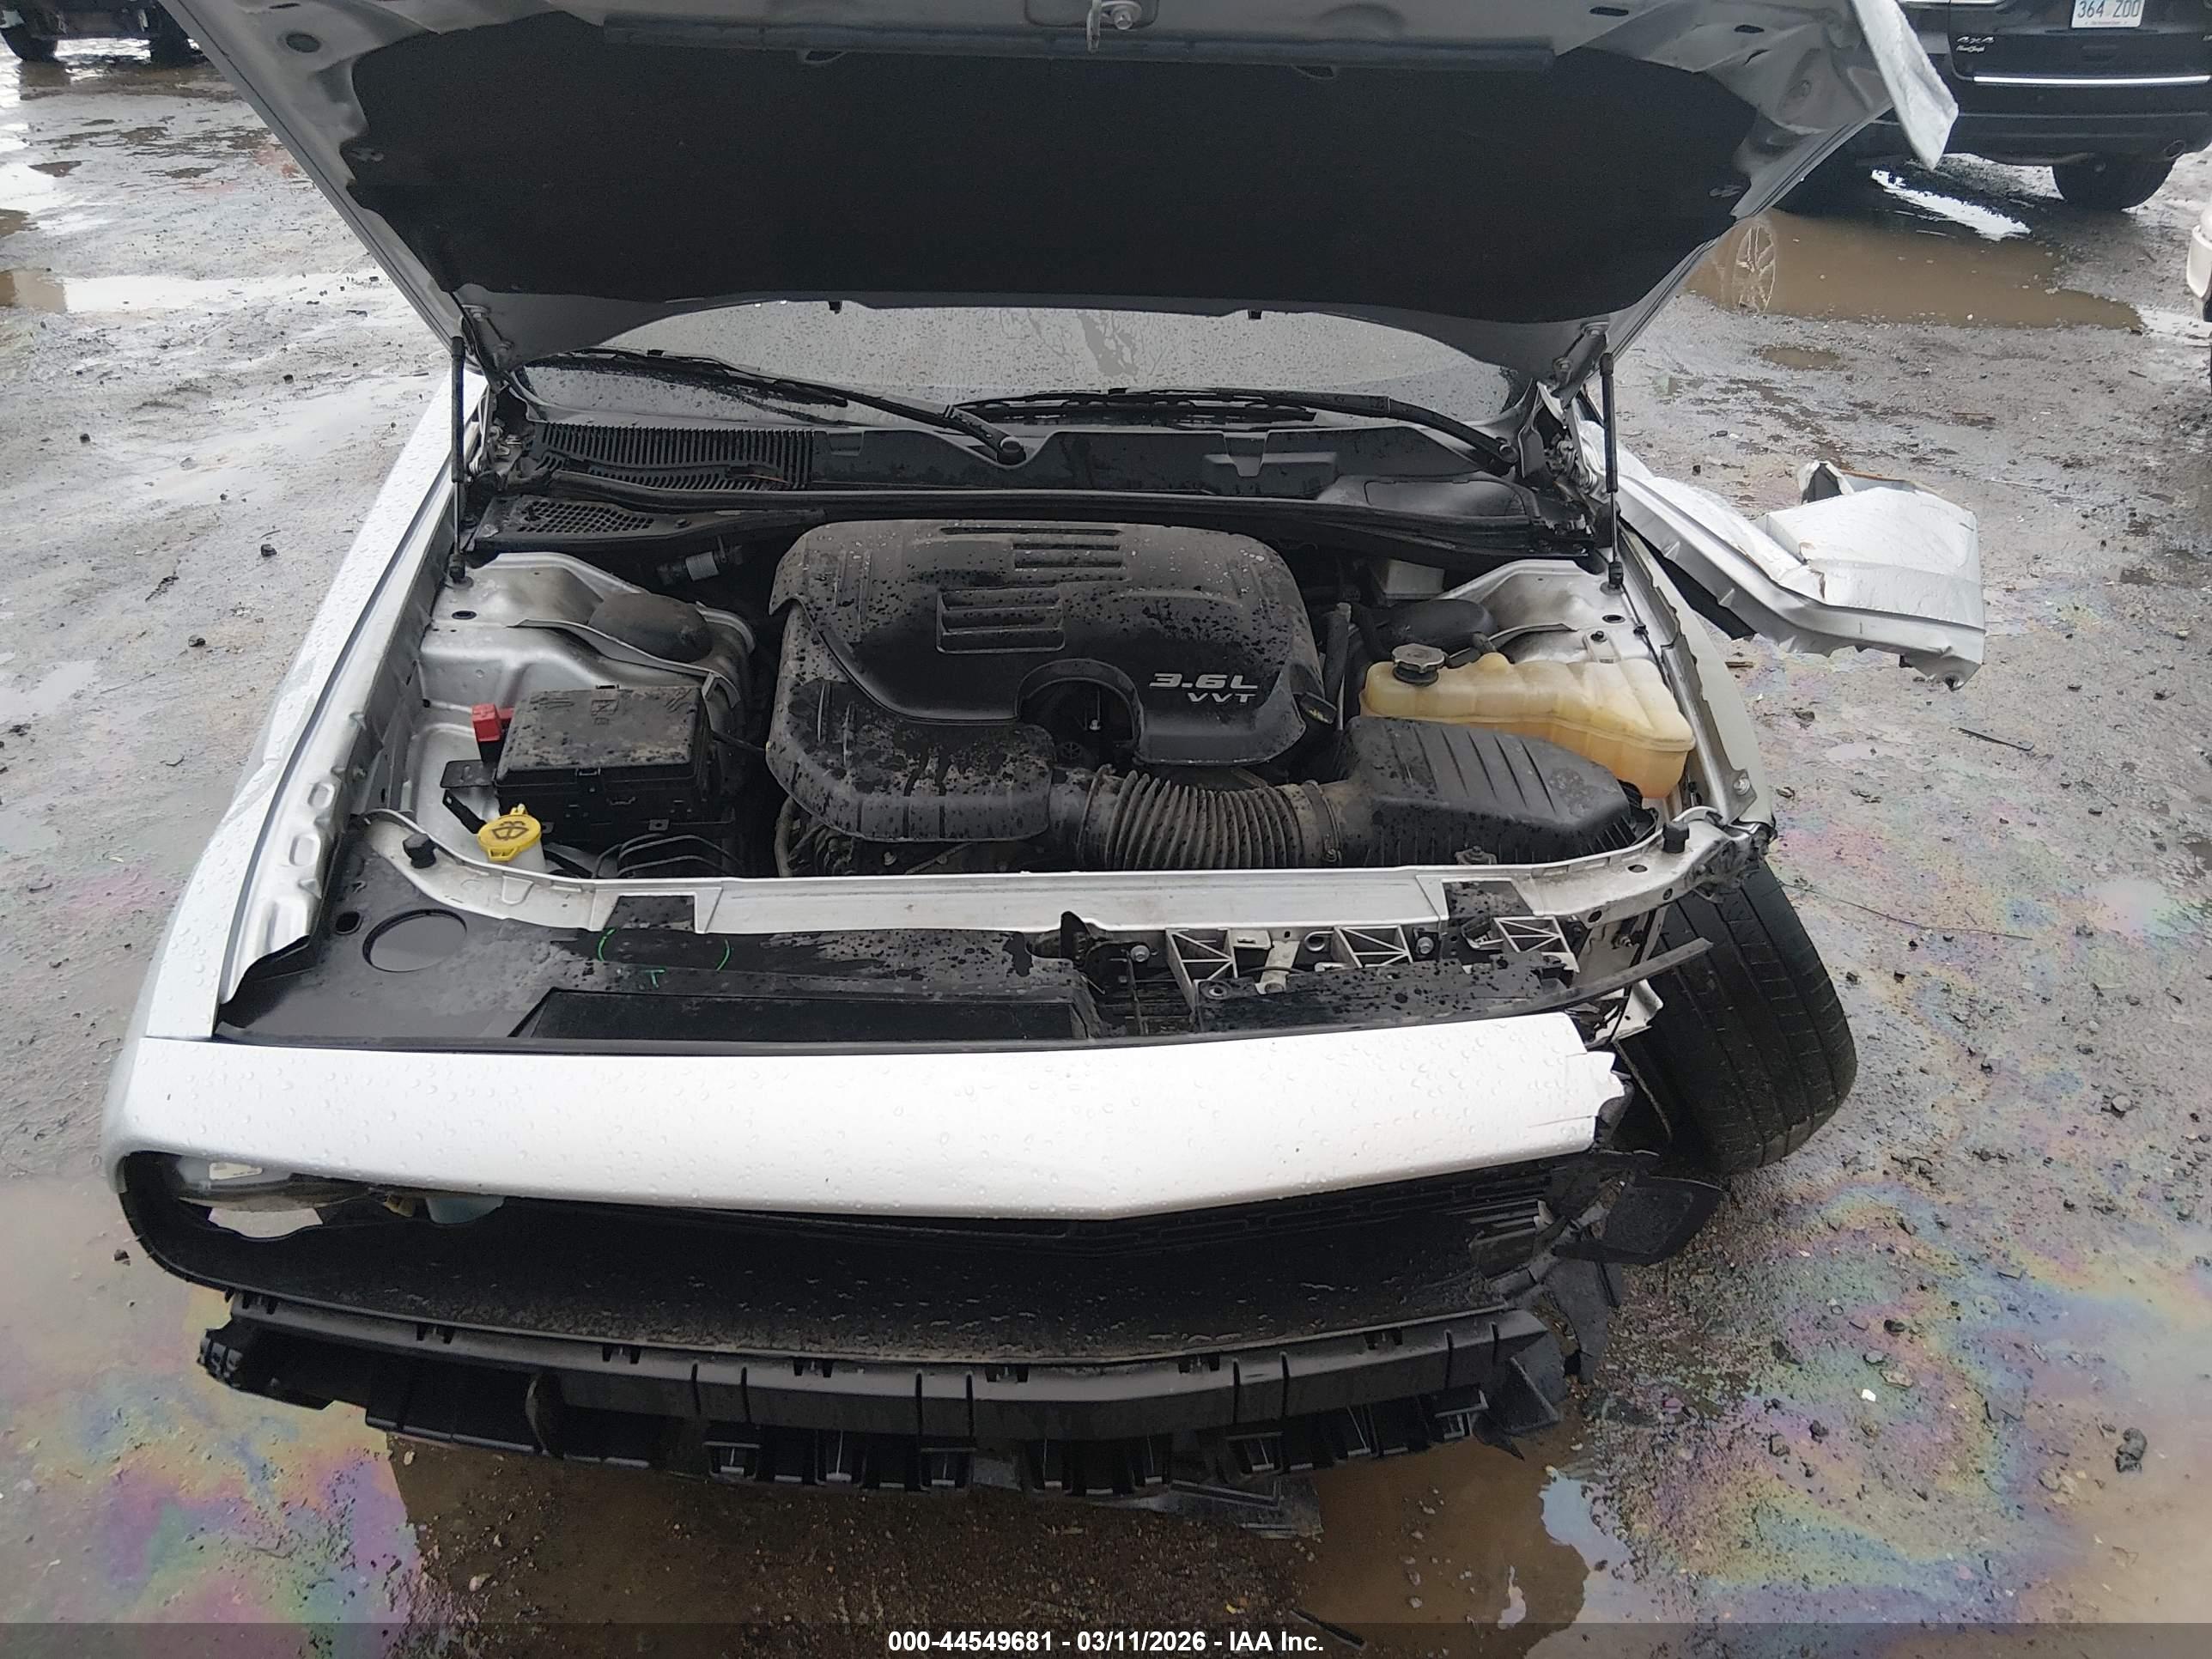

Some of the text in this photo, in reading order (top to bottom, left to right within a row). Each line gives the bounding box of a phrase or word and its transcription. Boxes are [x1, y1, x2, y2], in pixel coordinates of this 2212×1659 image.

[2078, 0, 2105, 17] 364
[1149, 672, 1258, 690] 3.6L
[1188, 692, 1256, 703] VVT
